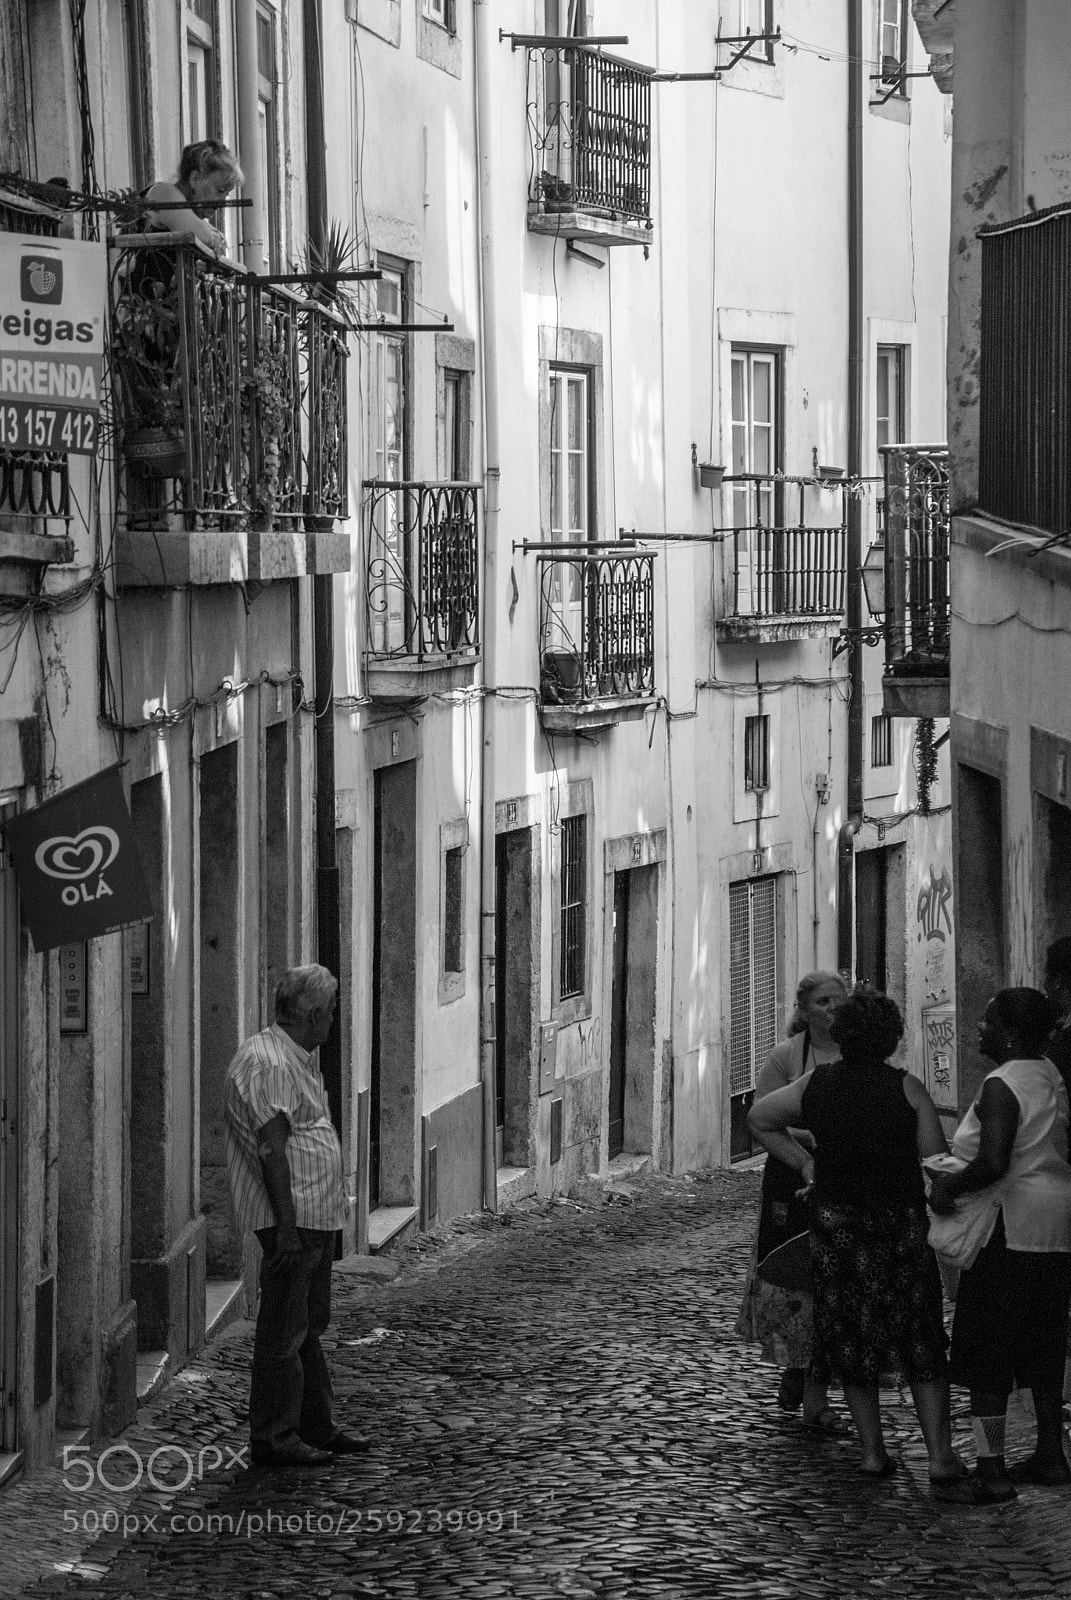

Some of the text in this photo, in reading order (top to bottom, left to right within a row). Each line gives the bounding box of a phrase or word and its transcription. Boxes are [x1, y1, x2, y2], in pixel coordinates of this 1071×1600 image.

[0, 309, 94, 345] eigas
[0, 357, 97, 400] RRENDA
[24, 408, 57, 446] 157
[61, 411, 94, 449] 412
[61, 872, 113, 906] OLÁ
